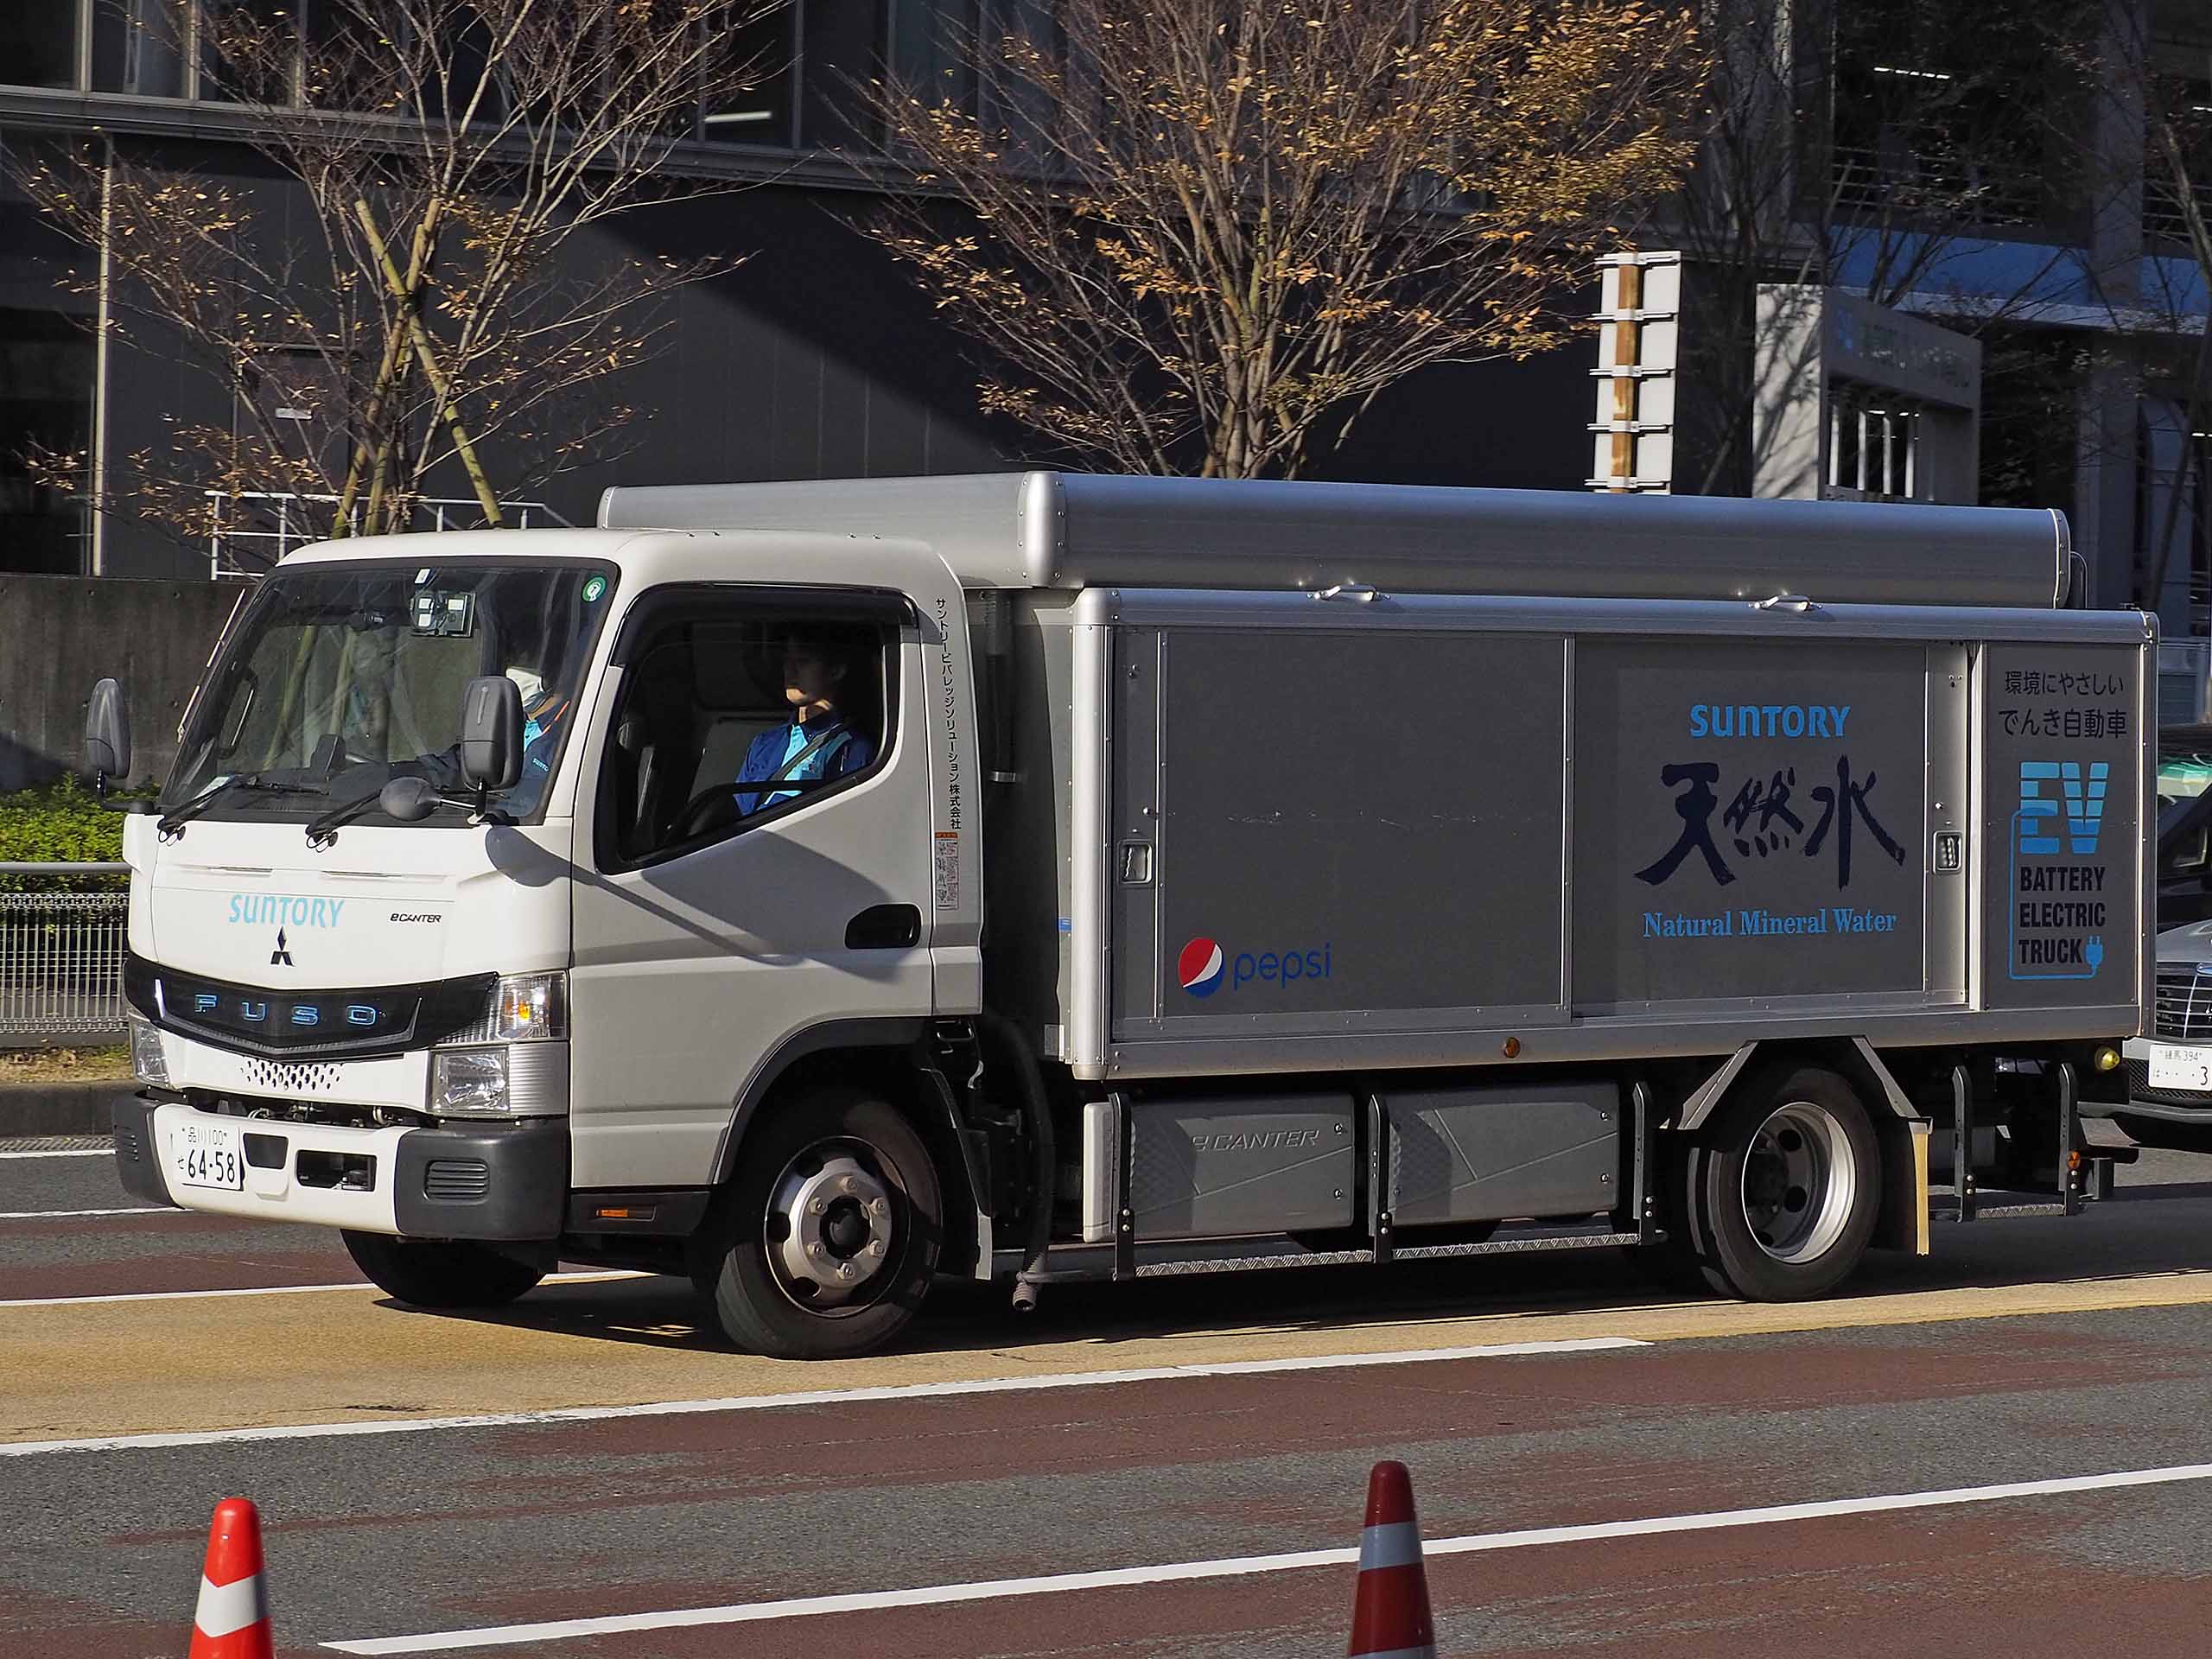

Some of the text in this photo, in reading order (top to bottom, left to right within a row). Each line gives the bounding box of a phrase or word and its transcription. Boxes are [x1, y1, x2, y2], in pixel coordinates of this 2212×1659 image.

[2005, 671, 2124, 696] 環境にやさしい
[936, 598, 962, 830] サントリービバレッジソリューション株式会社
[1690, 704, 1852, 738] SUNTORY
[1999, 709, 2127, 739] でんき自動車
[1632, 753, 1906, 893] 天然水
[2018, 761, 2109, 855] EV
[2019, 866, 2106, 893] BATTERY
[229, 893, 345, 929] SUNTORY
[1643, 907, 1897, 938] Natural Mineral Water
[2019, 902, 2107, 928] ELECTRIC
[1232, 942, 1332, 991] pepsi
[2018, 939, 2083, 964] TRUCK
[194, 995, 377, 1027] FUSO
